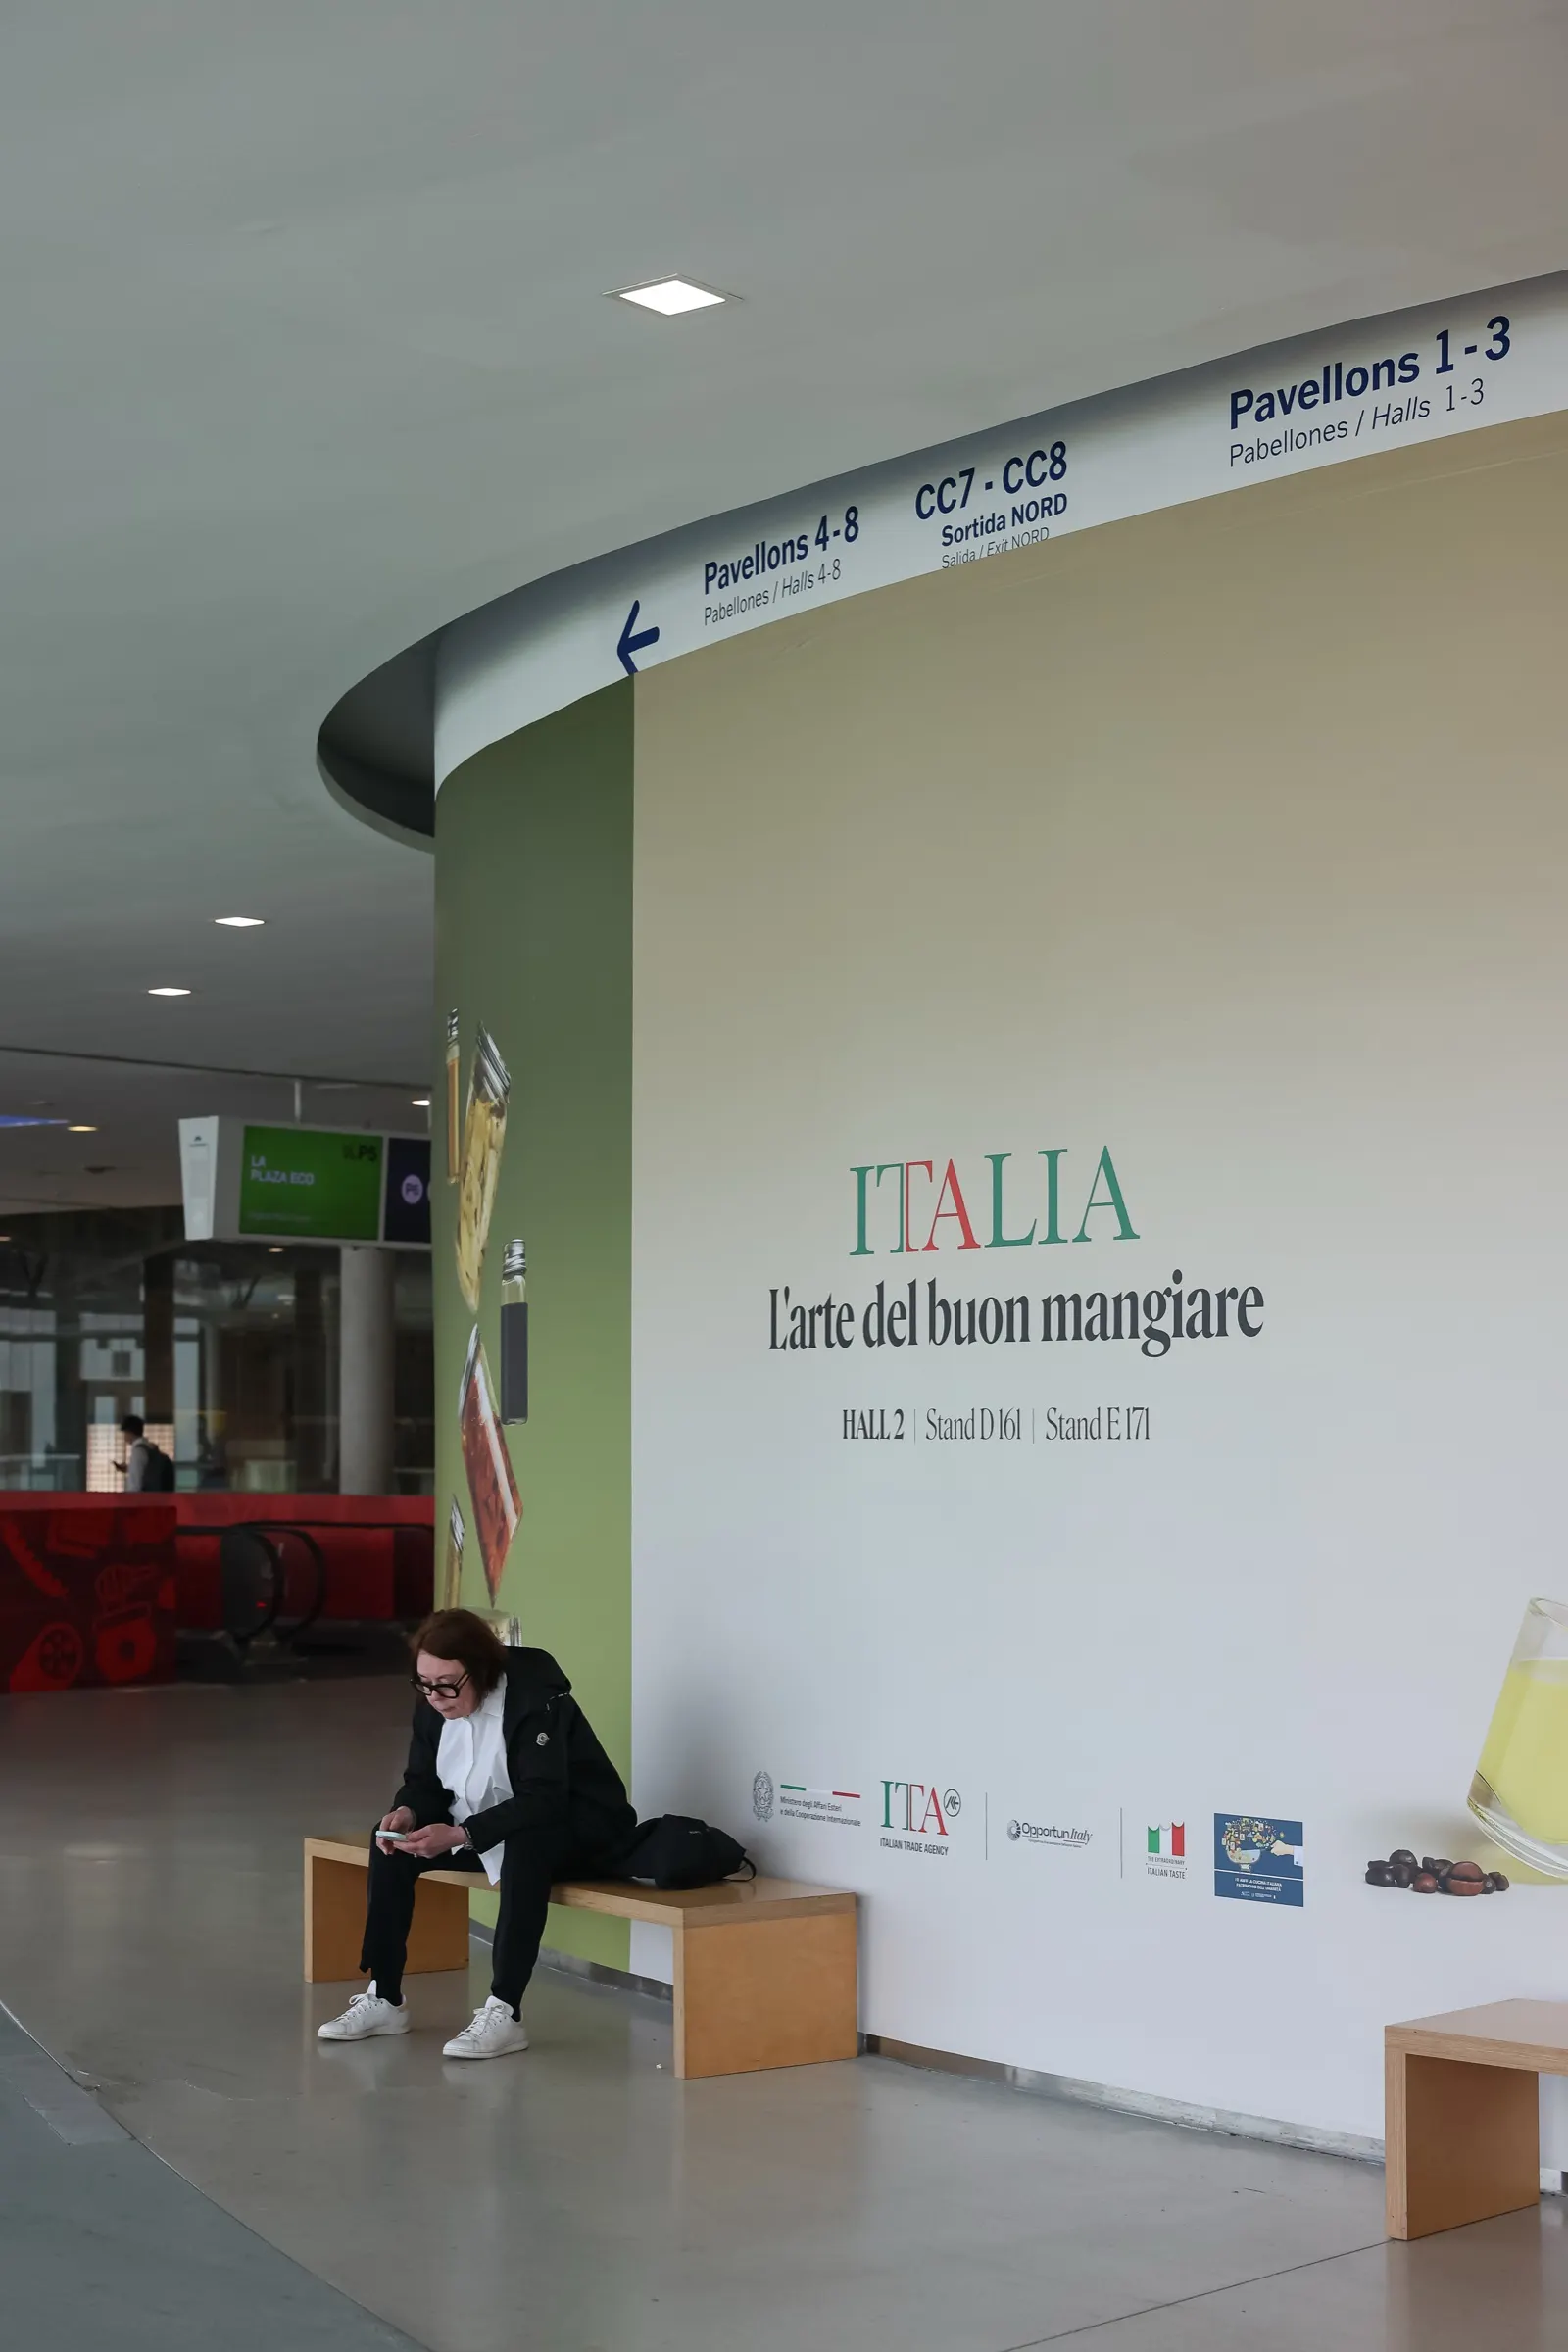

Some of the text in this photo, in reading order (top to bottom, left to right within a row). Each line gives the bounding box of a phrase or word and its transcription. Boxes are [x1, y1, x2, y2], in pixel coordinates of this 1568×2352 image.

[1230, 352, 1420, 430] Pavellons
[1230, 420, 1348, 467] Pabellones
[1372, 396, 1430, 430] Halls
[915, 467, 975, 520] CC7
[1003, 441, 1067, 495] CC8
[941, 492, 1067, 547] Sortida NORD
[942, 548, 976, 569] Salida
[987, 538, 1008, 557] Exit
[1011, 526, 1050, 550] NORD
[705, 506, 859, 595] Pavellons 4-8
[705, 589, 769, 626] Pabellones
[782, 571, 814, 598] Halls
[817, 559, 842, 584] 4-8
[849, 1145, 1141, 1256] ITALIA
[768, 1269, 1264, 1358] L'arte del buon mangiare
[842, 1408, 890, 1440] HALL
[893, 1408, 905, 1440] 2
[925, 1406, 976, 1441] Stand
[1045, 1406, 1102, 1441] Stand
[780, 1796, 802, 1807] Ministero
[802, 1799, 812, 1810] degli
[827, 1802, 842, 1812] Esteri
[784, 1808, 795, 1817] della
[795, 1809, 826, 1822] Cooperazione
[826, 1814, 861, 1827] Internazionale
[880, 1780, 949, 1837] ITA
[880, 1838, 949, 1856] ITALIAN TRADE AGENCY
[1147, 1867, 1186, 1880] ITALIAN TASTE
